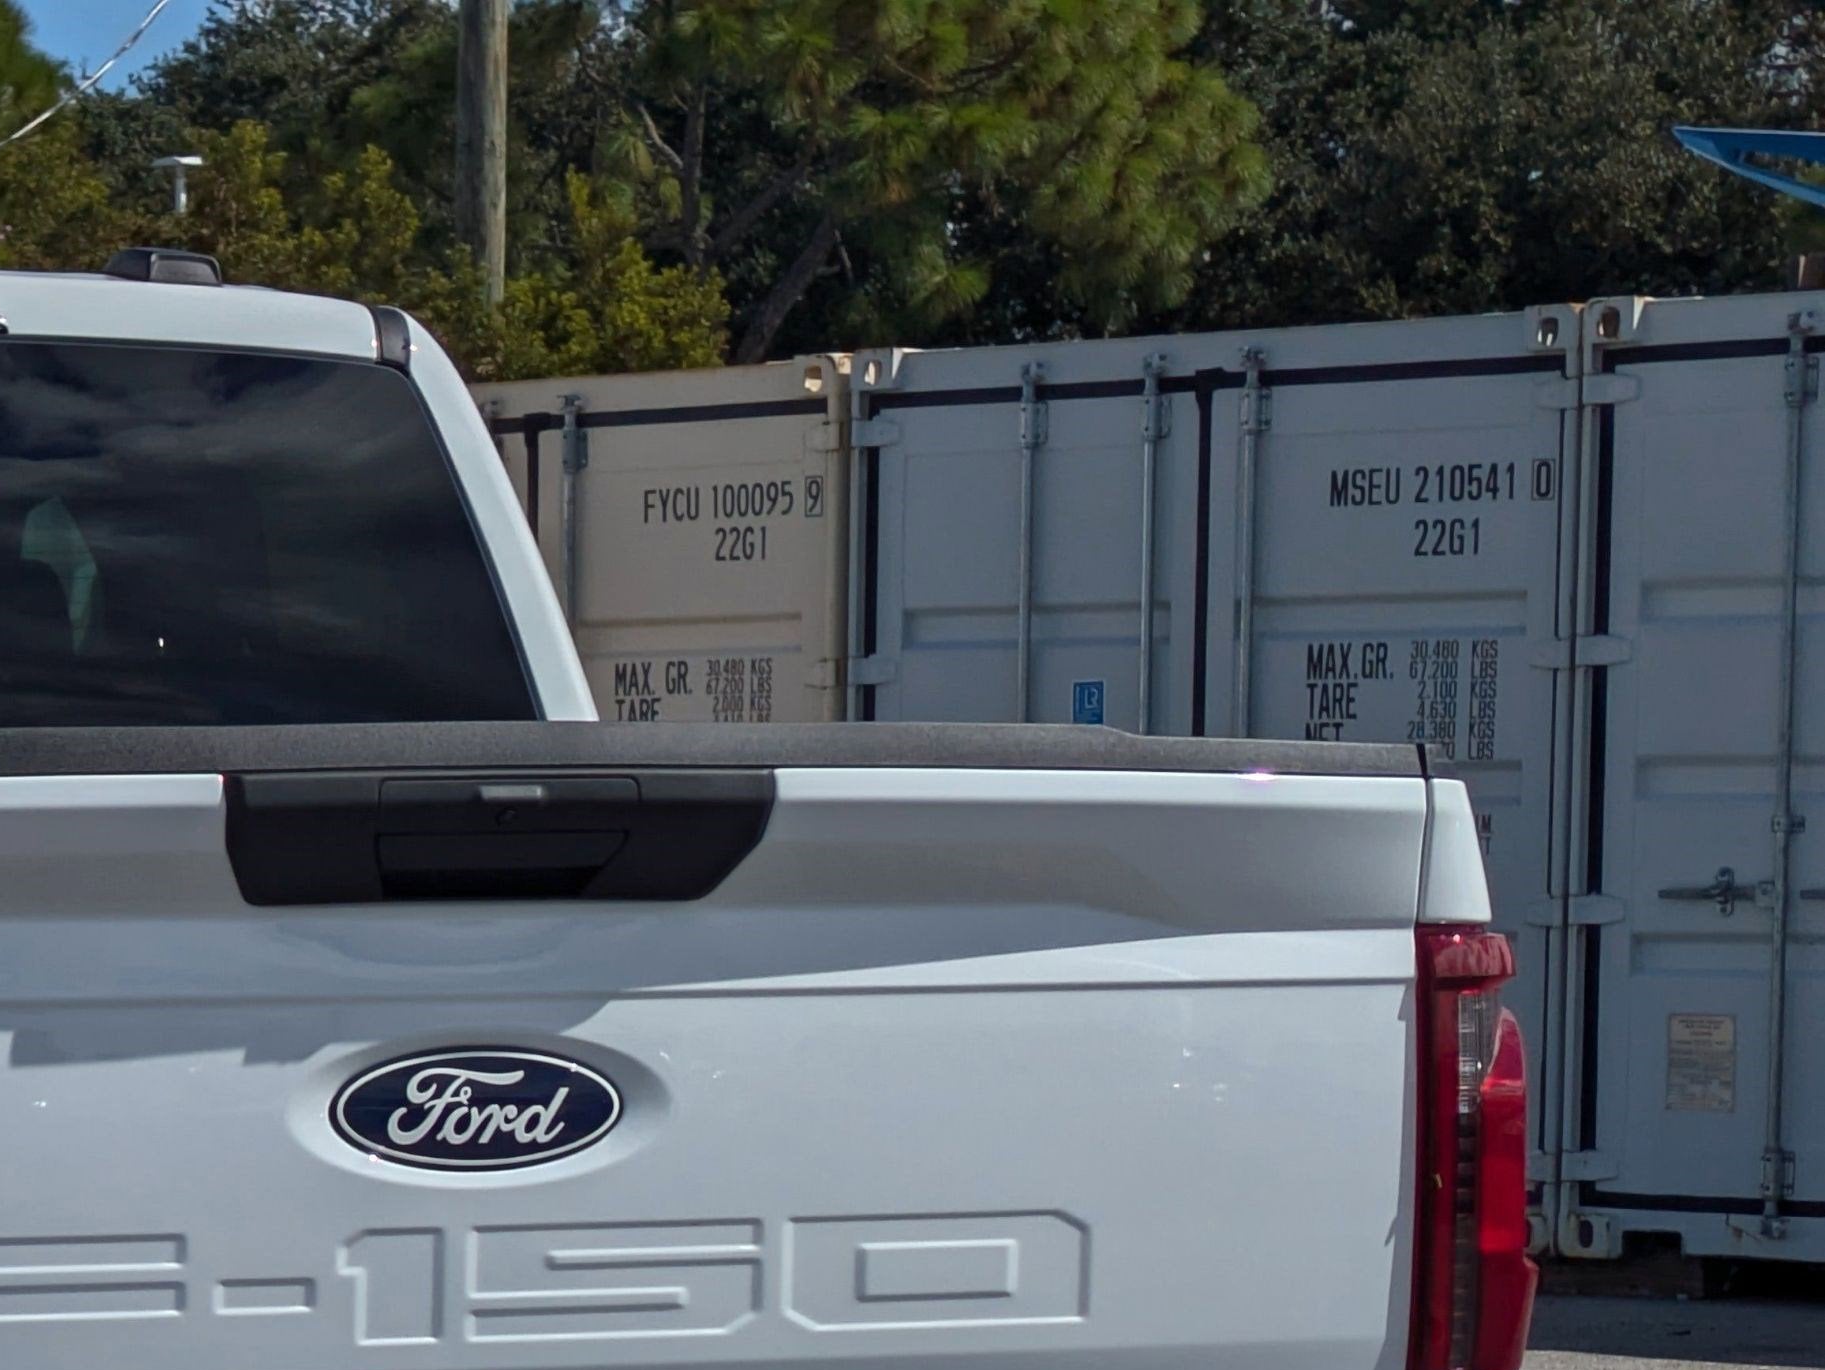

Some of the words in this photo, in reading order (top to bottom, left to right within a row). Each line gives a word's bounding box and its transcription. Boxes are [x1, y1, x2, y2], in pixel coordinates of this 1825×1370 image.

[1329, 467, 1401, 507] MSEU
[1414, 462, 1515, 503] 210541
[644, 487, 700, 524] FYCU
[712, 480, 794, 519] 100095
[807, 478, 822, 514] 9
[715, 526, 766, 561] 22G1
[1414, 518, 1480, 556] 22G1
[1410, 640, 1460, 660] 30.480
[1472, 640, 1498, 660] KGS
[615, 661, 655, 697] MAX.
[665, 660, 693, 695] GR.
[750, 658, 773, 677] KGS
[750, 676, 773, 695] LBS
[1409, 660, 1458, 680] 67.200
[1471, 660, 1498, 680] LBS
[615, 698, 661, 722] TARE
[750, 695, 772, 714] KGS
[1306, 682, 1358, 720] TARE
[1417, 681, 1457, 700] 2.100
[1470, 680, 1497, 700] KGS
[1416, 701, 1457, 720] 4.630
[1469, 700, 1496, 720] LBS
[1468, 720, 1495, 740] KGS
[1468, 740, 1494, 760] LBS
[387, 1067, 570, 1145] Ford
